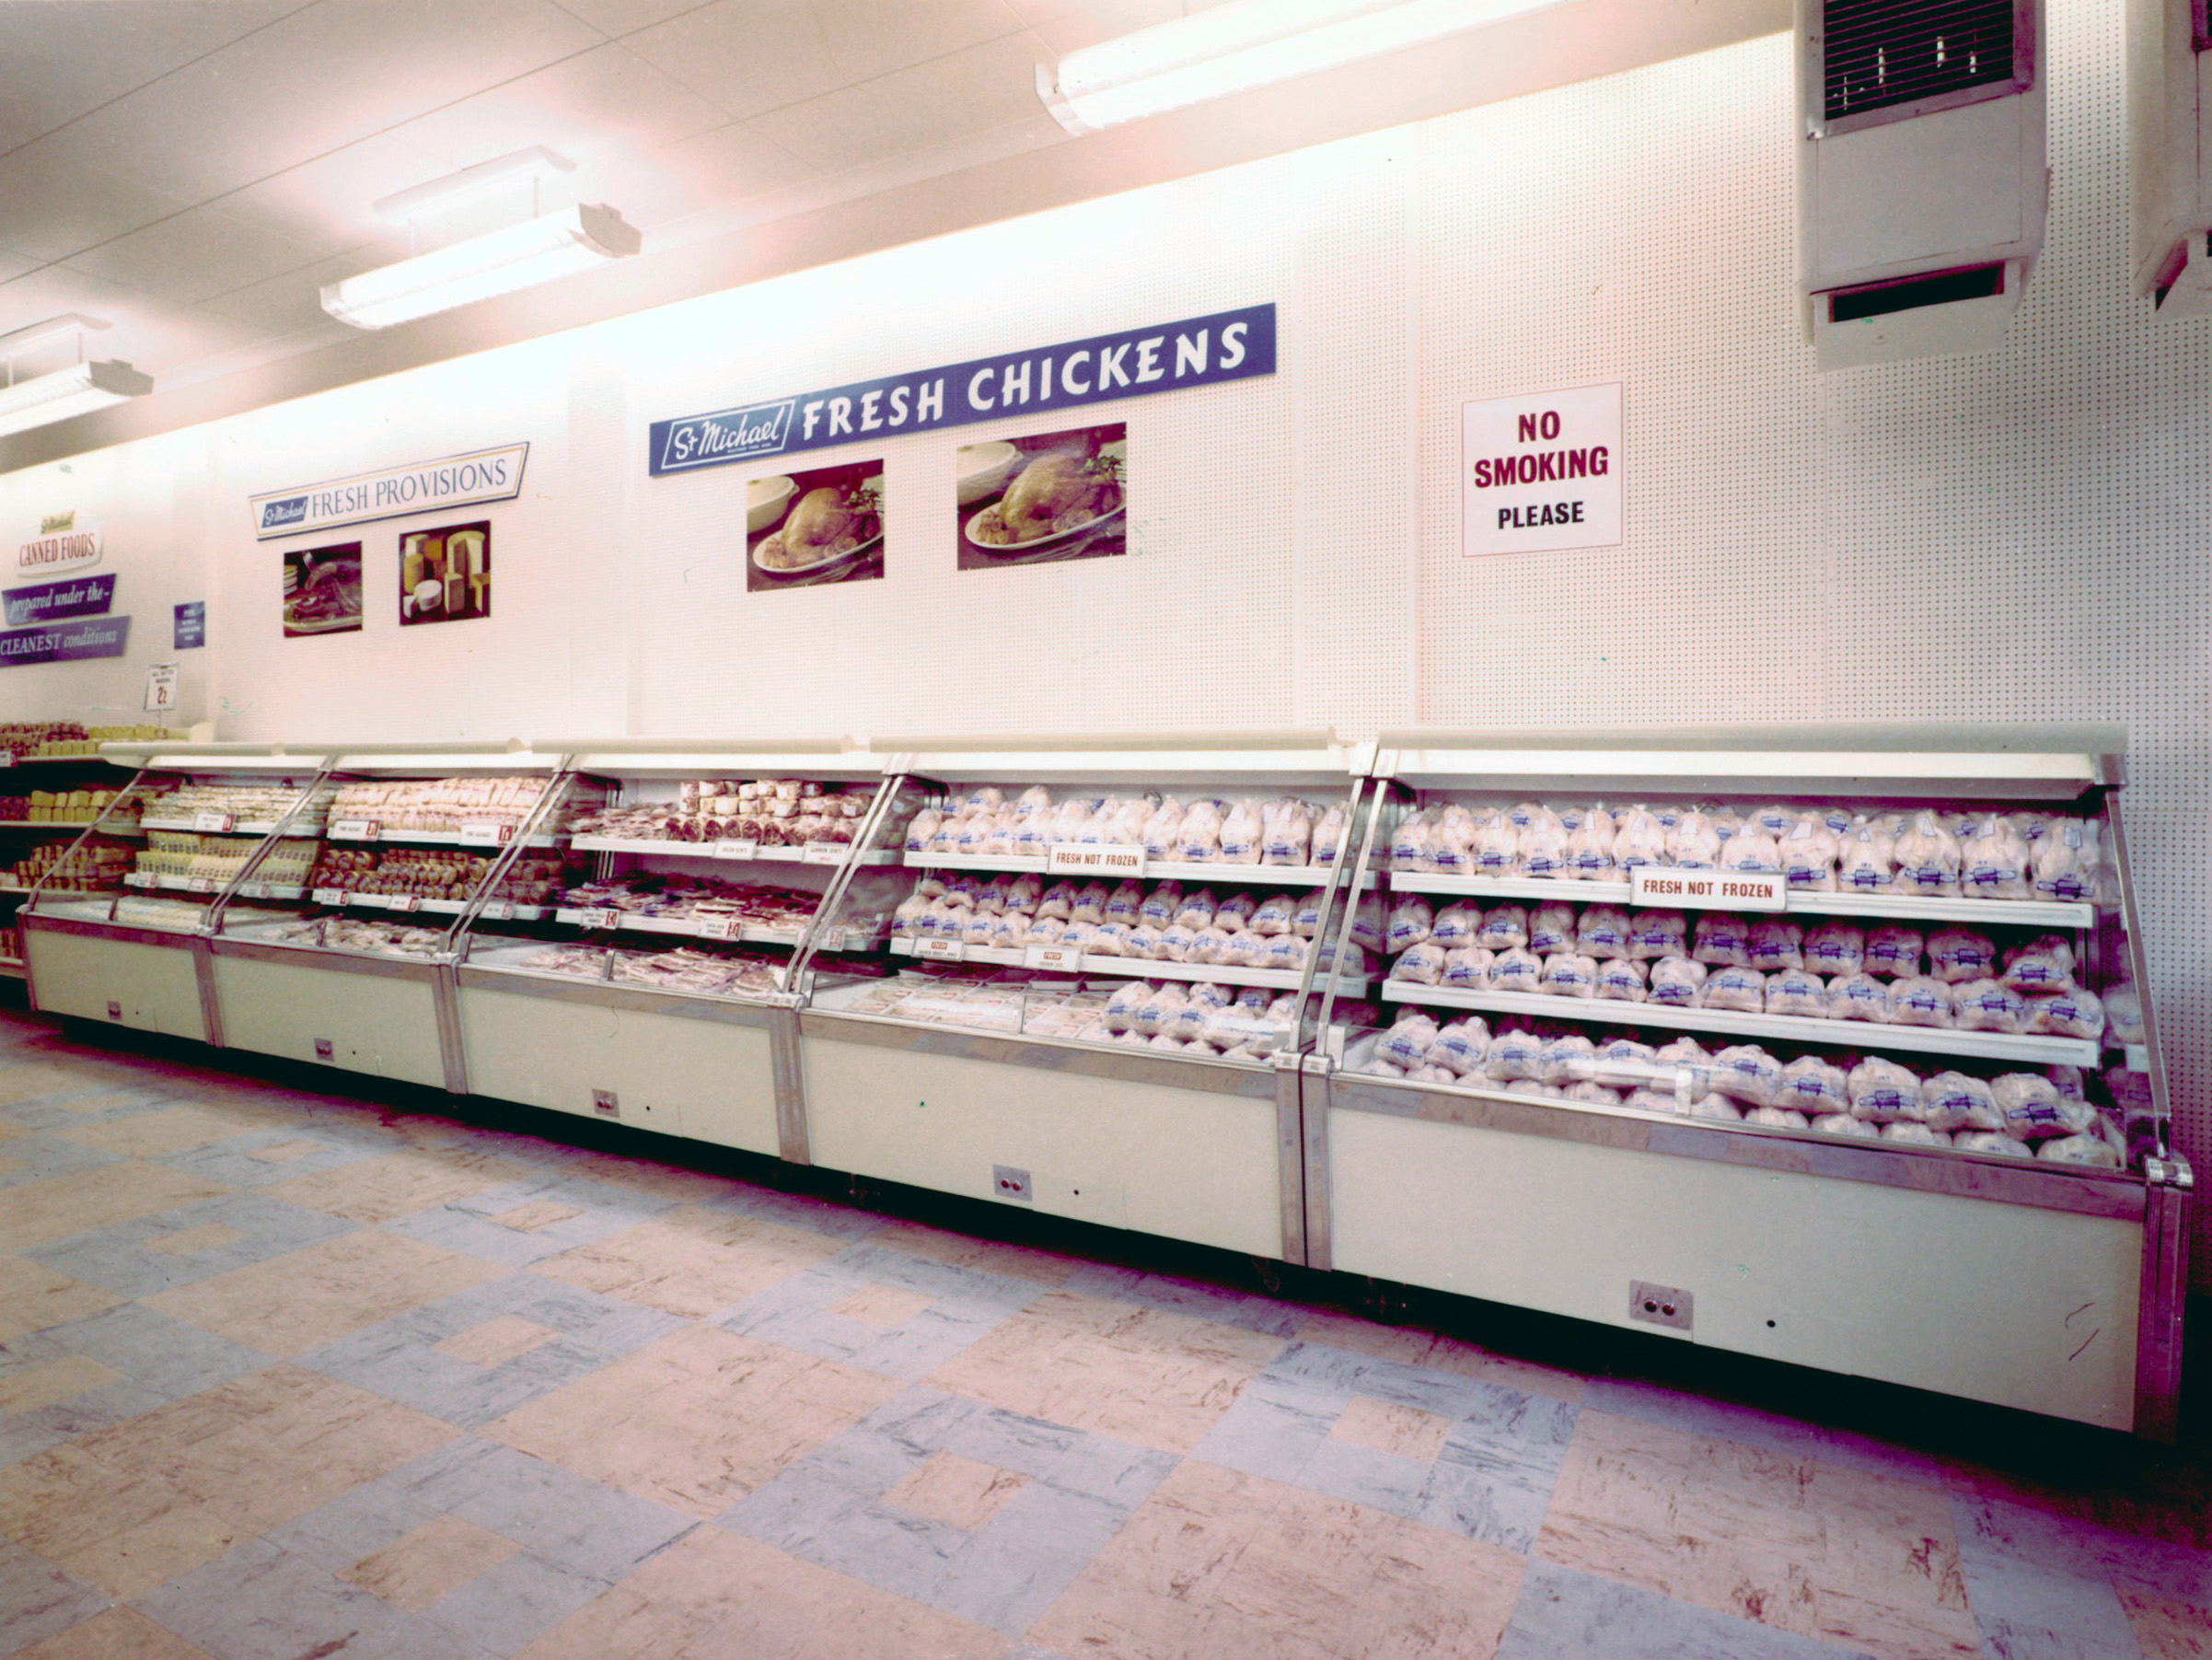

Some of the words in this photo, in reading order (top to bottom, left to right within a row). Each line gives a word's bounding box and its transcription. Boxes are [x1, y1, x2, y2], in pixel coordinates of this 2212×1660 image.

[674, 426, 699, 460] St
[698, 405, 786, 457] Michael
[802, 377, 944, 441] FRESH
[967, 321, 1248, 412] CHICKENS
[1518, 410, 1561, 444] NO
[1474, 446, 1609, 489] SMOKING
[274, 498, 307, 522] Michael
[312, 484, 368, 518] FRESH
[376, 459, 507, 507] PROVISIONS
[1498, 500, 1585, 530] PLEASE
[18, 538, 59, 567] CANNED
[61, 532, 96, 561] FOODS
[9, 587, 53, 619] prepared
[54, 584, 86, 607] under
[0, 633, 63, 656] CLEANEST
[64, 626, 118, 648] conditions
[1056, 852, 1083, 865] FRESH
[1083, 853, 1103, 865] NOT
[1105, 854, 1139, 867] FROZEN
[1643, 879, 1683, 895] FRESH
[1687, 881, 1714, 896] NOT
[1721, 882, 1774, 899] FROZEN
